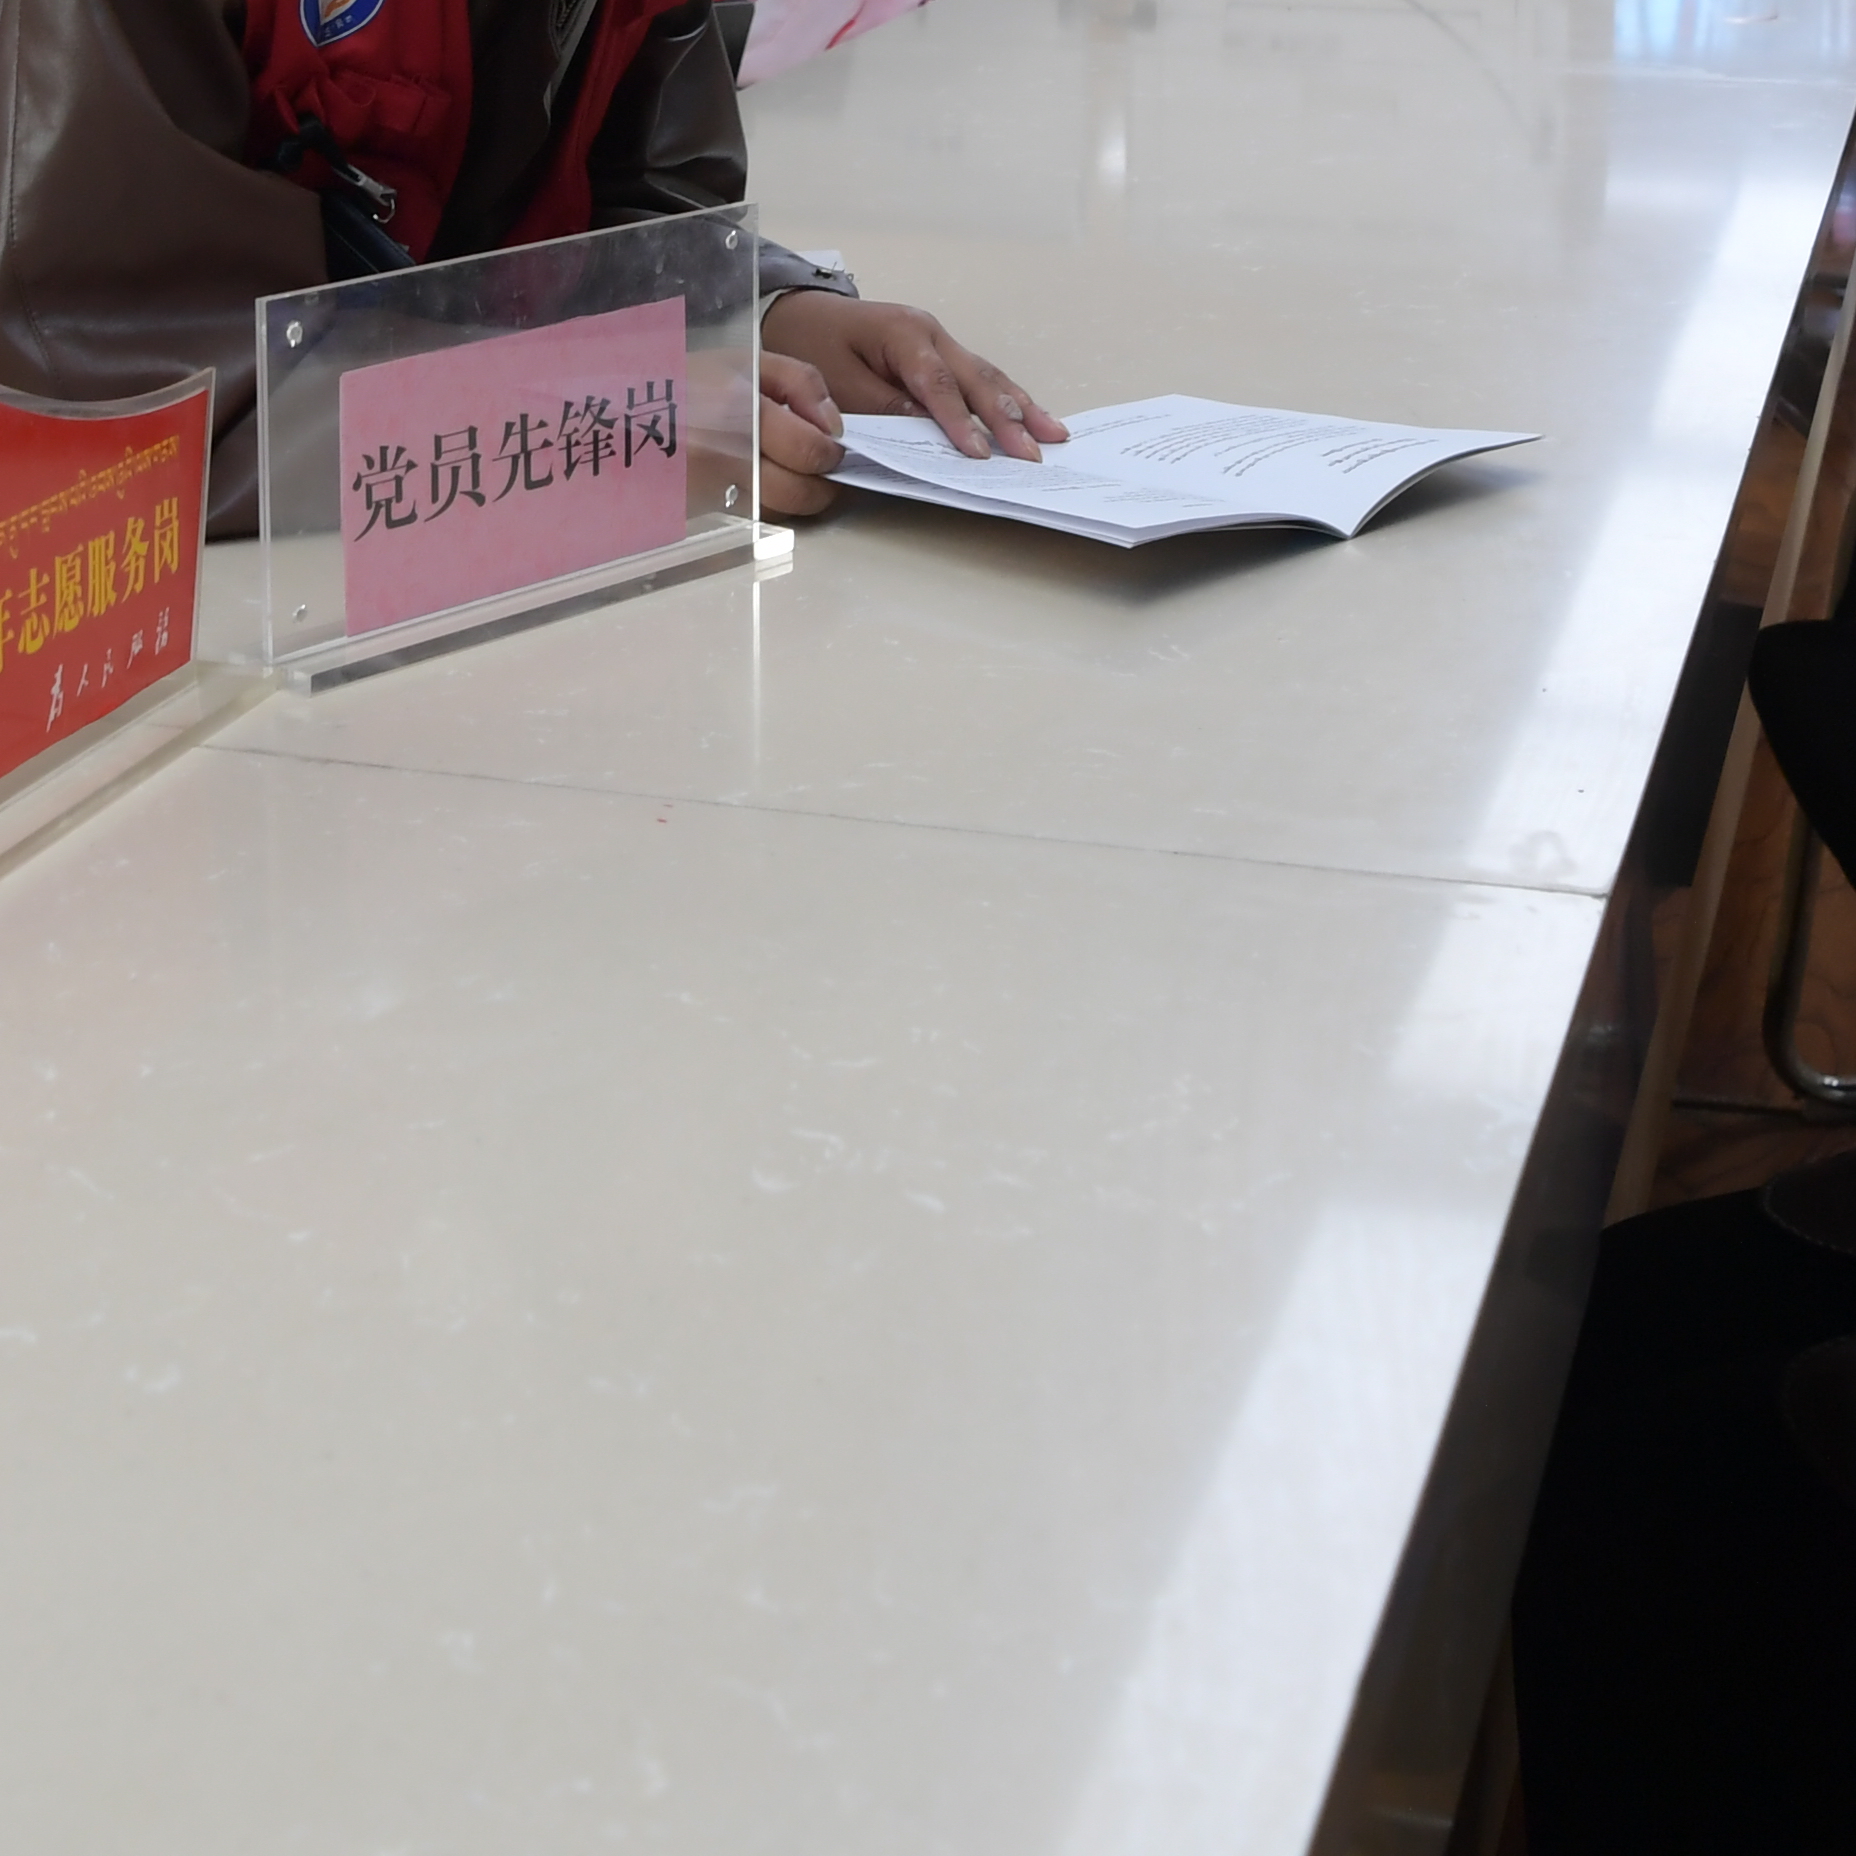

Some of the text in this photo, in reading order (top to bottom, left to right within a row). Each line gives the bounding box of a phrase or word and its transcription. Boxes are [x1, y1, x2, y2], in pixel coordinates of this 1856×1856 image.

[351, 377, 678, 543] 党员先锋岗
